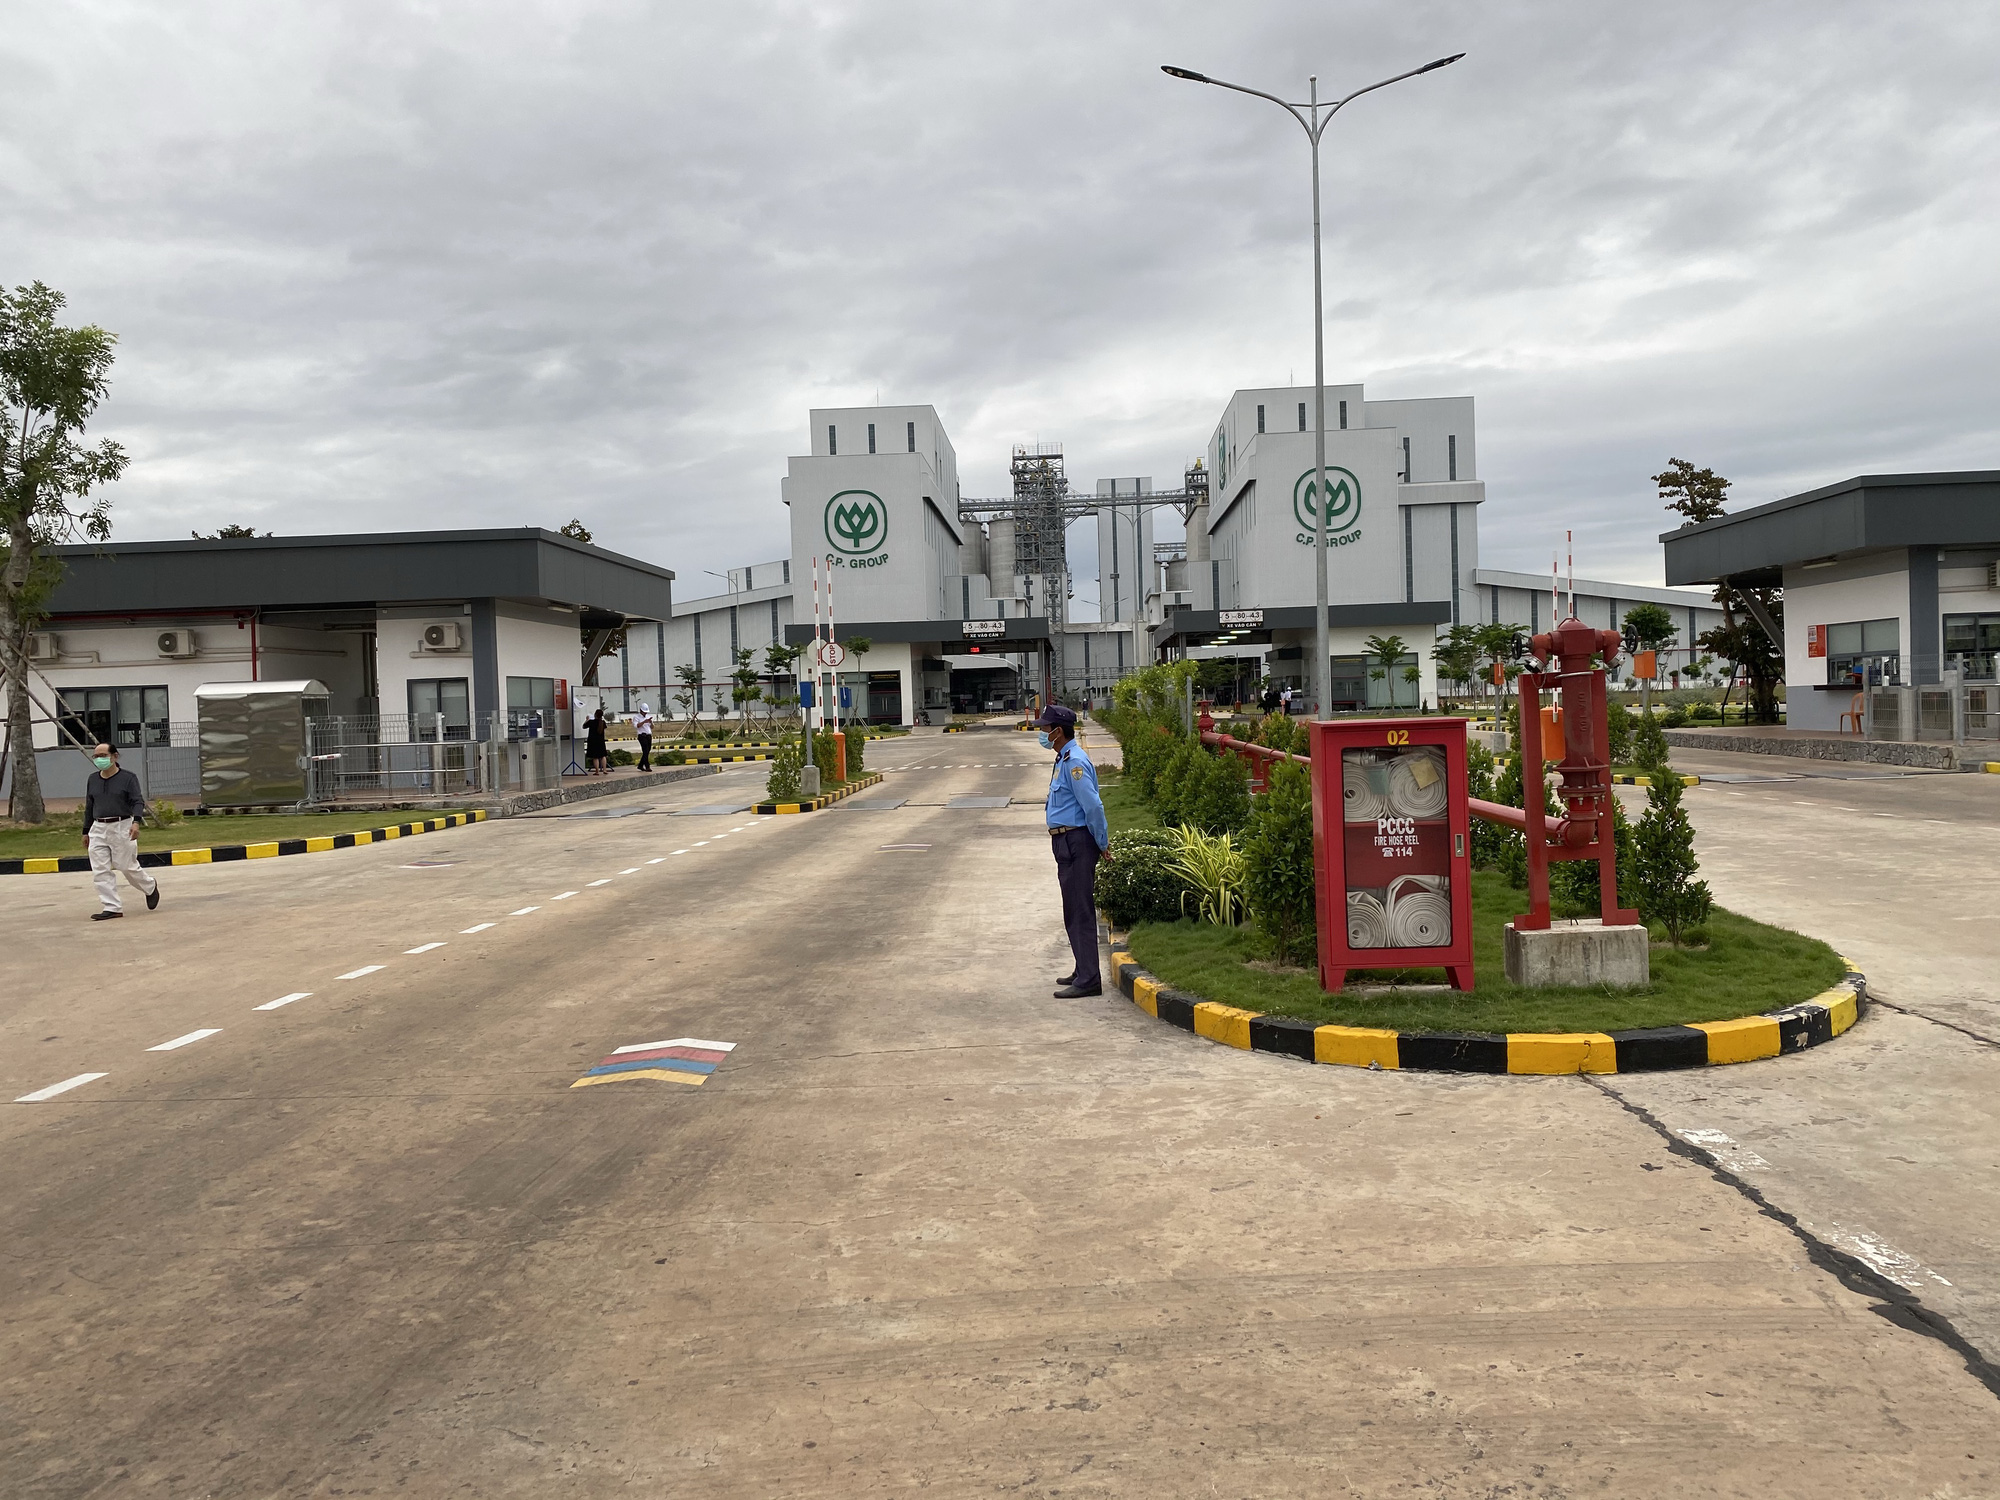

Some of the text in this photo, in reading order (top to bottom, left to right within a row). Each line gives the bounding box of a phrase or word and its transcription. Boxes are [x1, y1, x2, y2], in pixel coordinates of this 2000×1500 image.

[1296, 532, 1316, 548] C.P.
[850, 553, 888, 568] GROUP
[1387, 730, 1410, 746] 02
[1377, 818, 1415, 835] PCCC
[1374, 835, 1387, 846] FIRE
[1388, 835, 1404, 846] HOSE
[1396, 846, 1413, 857] 114
